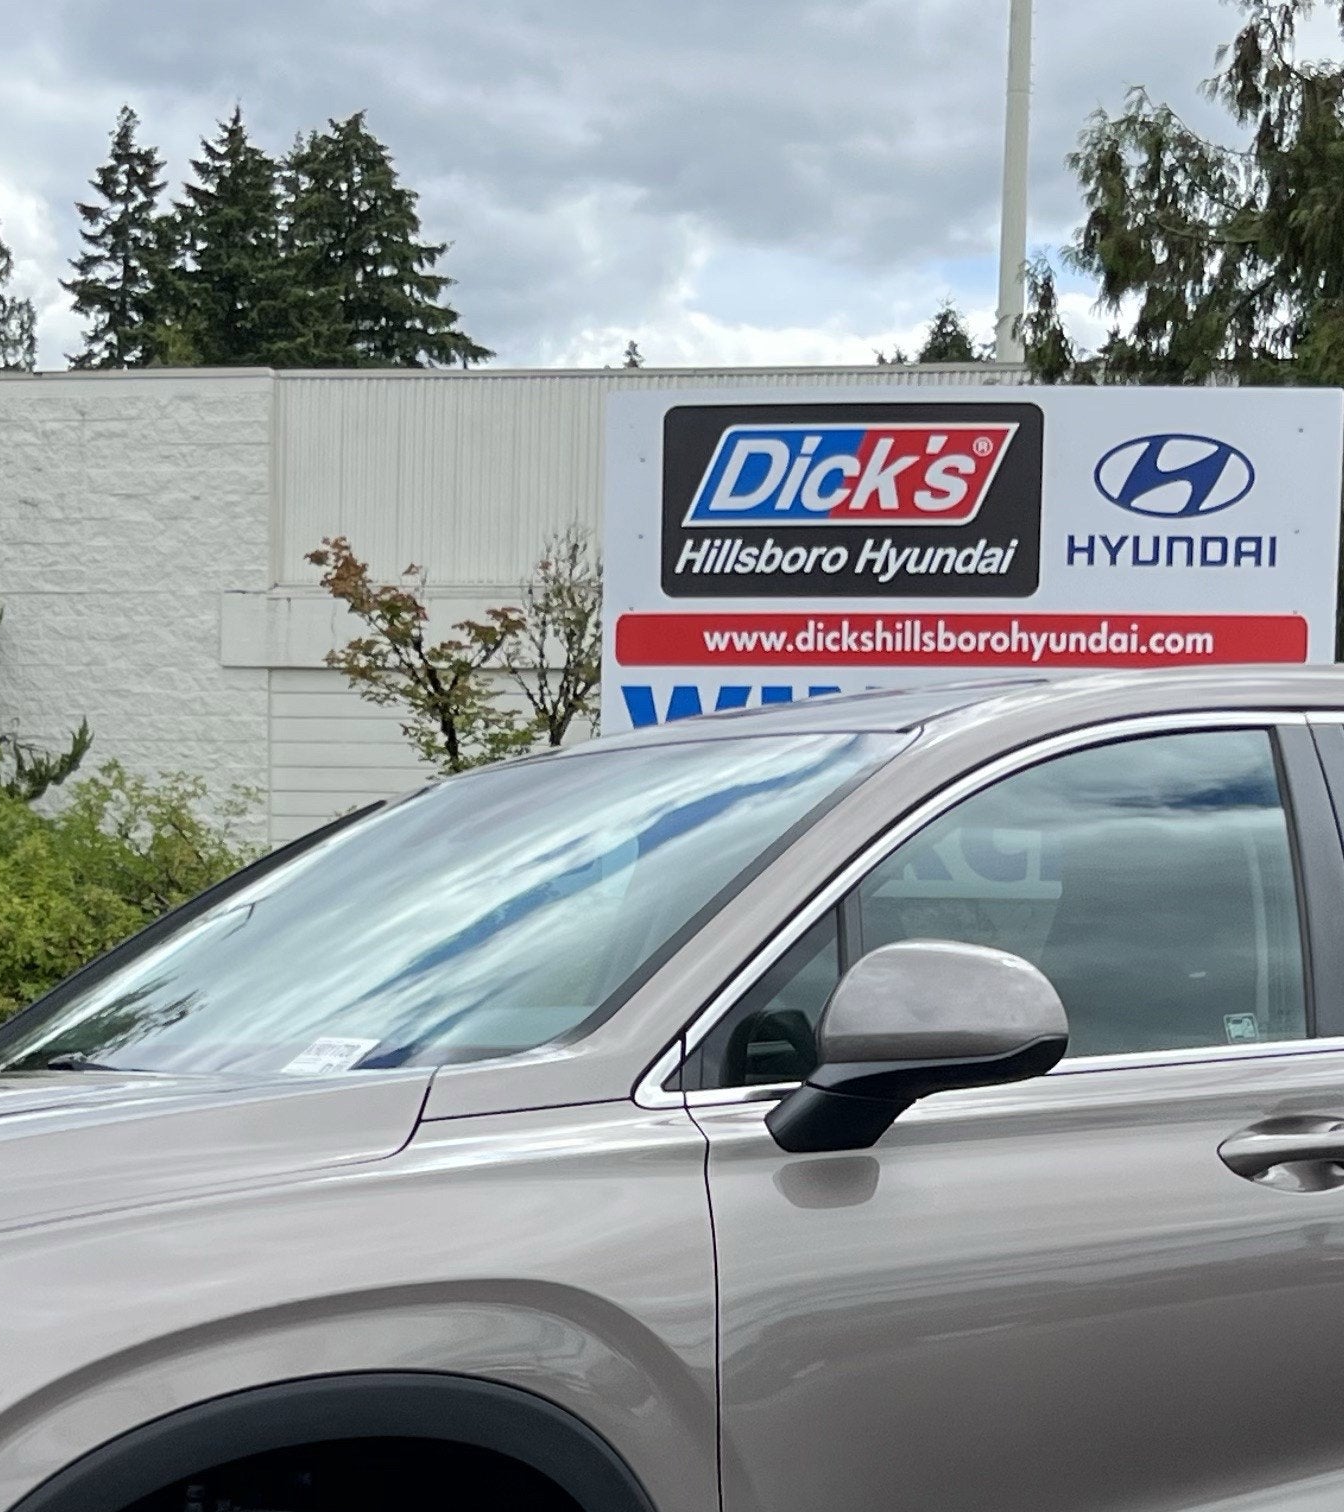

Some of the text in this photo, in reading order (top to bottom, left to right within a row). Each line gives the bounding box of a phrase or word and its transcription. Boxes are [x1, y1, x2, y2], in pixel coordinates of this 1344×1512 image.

[708, 434, 976, 512] Dick's
[675, 538, 1018, 583] Hillsboro Hyundai
[1066, 535, 1277, 568] HYUNDAI
[702, 620, 1214, 662] www.dickshillsborohyundai.com
